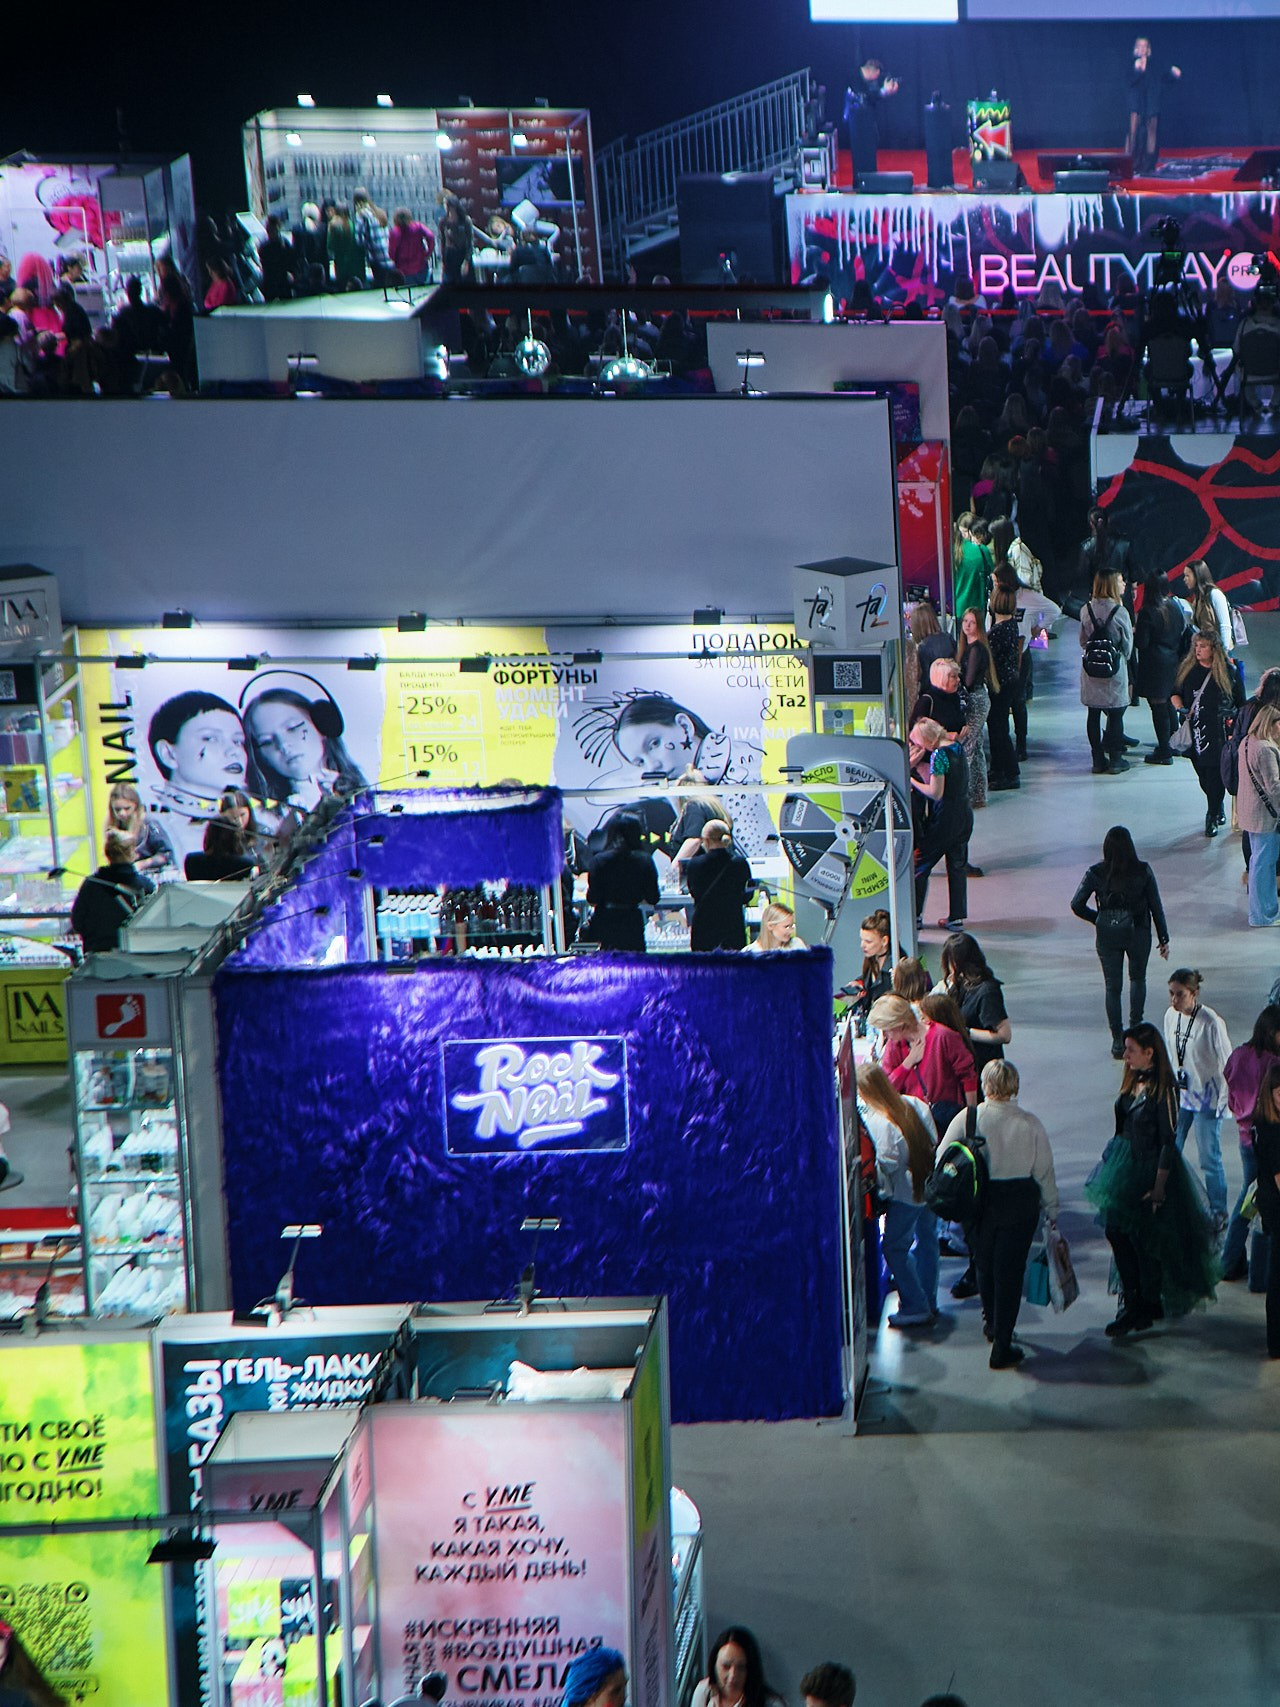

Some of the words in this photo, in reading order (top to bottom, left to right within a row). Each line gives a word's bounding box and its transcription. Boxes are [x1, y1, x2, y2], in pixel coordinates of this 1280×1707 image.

[693, 633, 804, 652] ПОДАРОК
[493, 668, 598, 685] ФОРТУНЫ
[495, 686, 587, 703] МОМЕНТ
[496, 703, 569, 723] УДАЧИ
[760, 697, 778, 721] &
[13, 991, 62, 1019] IVA
[475, 1041, 619, 1093] Rock
[452, 1079, 607, 1139] Nail
[40, 1414, 105, 1441] СВОЁ
[454, 1516, 467, 1534] Я
[473, 1514, 546, 1534] ТАКАЯ,
[431, 1539, 501, 1559] КАКАЯ
[507, 1537, 571, 1557] ХОЧУ,
[415, 1558, 518, 1583] КАЖДЫЙ
[523, 1558, 588, 1582] ДЕНЬ!
[404, 1616, 560, 1638] #ИСКРЕННЯЯ
